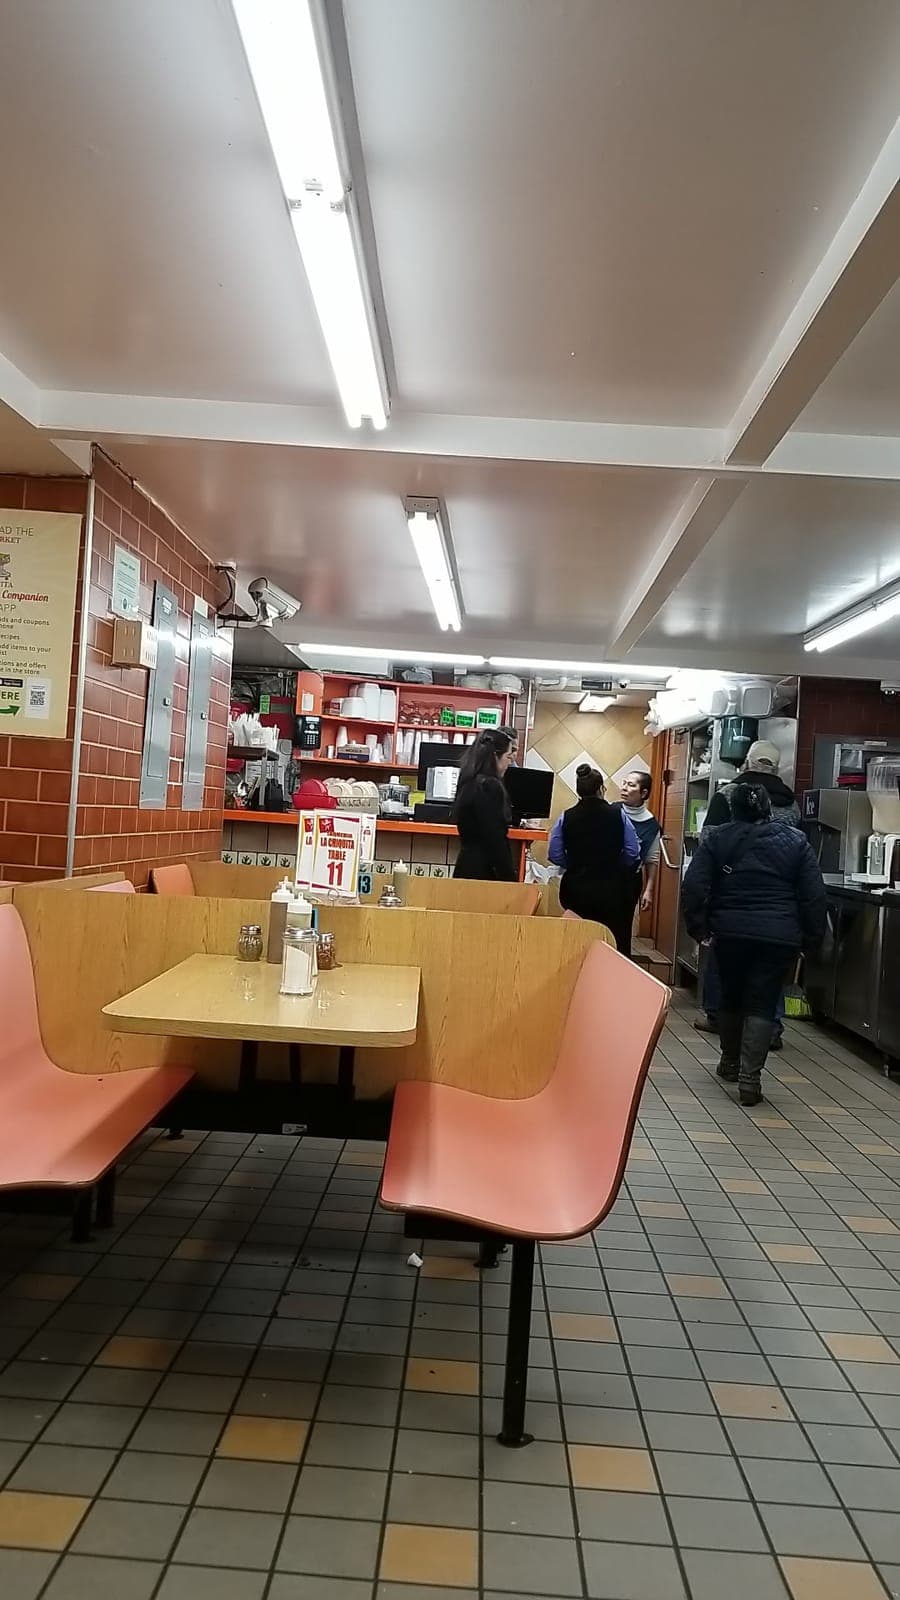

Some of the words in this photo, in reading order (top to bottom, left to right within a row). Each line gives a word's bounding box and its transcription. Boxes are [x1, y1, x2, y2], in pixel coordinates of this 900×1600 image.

[16, 527, 34, 536] THE
[2, 590, 49, 602] Companion
[321, 837, 327, 846] LA
[328, 838, 354, 849] CHIQUITA
[328, 850, 347, 861] TABLE
[327, 861, 344, 886] 11
